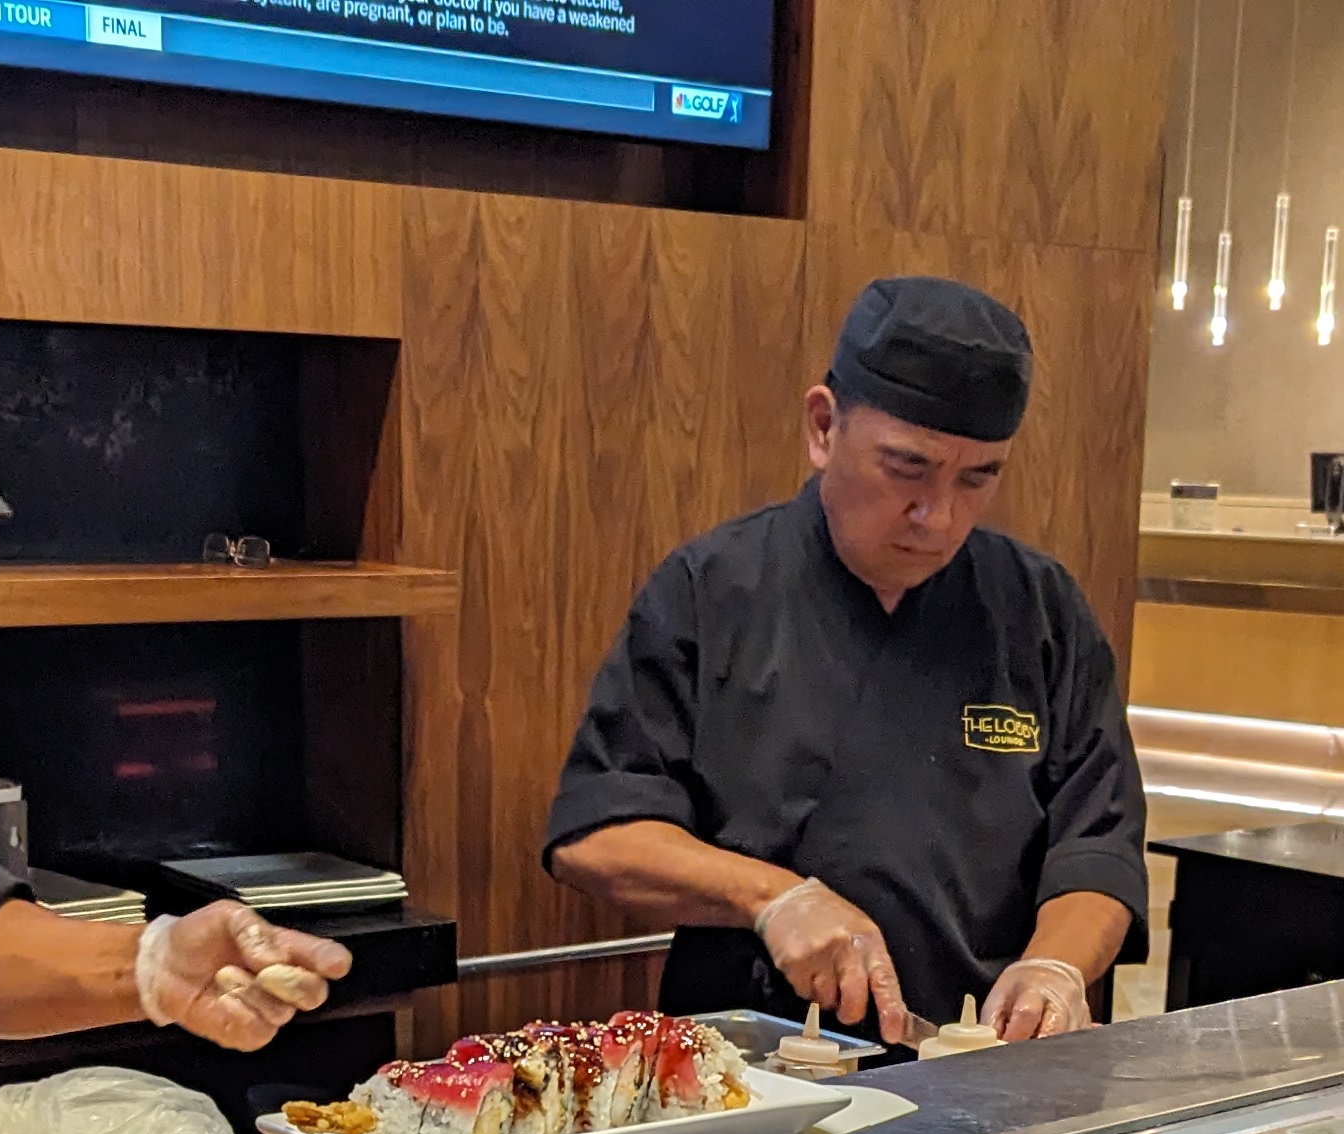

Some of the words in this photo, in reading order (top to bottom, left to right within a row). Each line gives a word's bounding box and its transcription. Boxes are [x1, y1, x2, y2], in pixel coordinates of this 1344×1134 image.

[1, 3, 52, 28] TOUR
[102, 16, 147, 38] FINAL
[316, 0, 341, 13] are
[343, 0, 414, 27] pregnant,
[417, 9, 434, 26] or
[436, 10, 467, 32] plan
[470, 14, 485, 33] to
[488, 16, 509, 38] be.
[495, 1, 519, 17] you
[523, 1, 555, 22] have
[557, 8, 567, 23] a
[569, 11, 635, 34] weakened
[692, 95, 724, 113] GOLF
[961, 717, 993, 733] THE
[995, 718, 1041, 739] LOBBY
